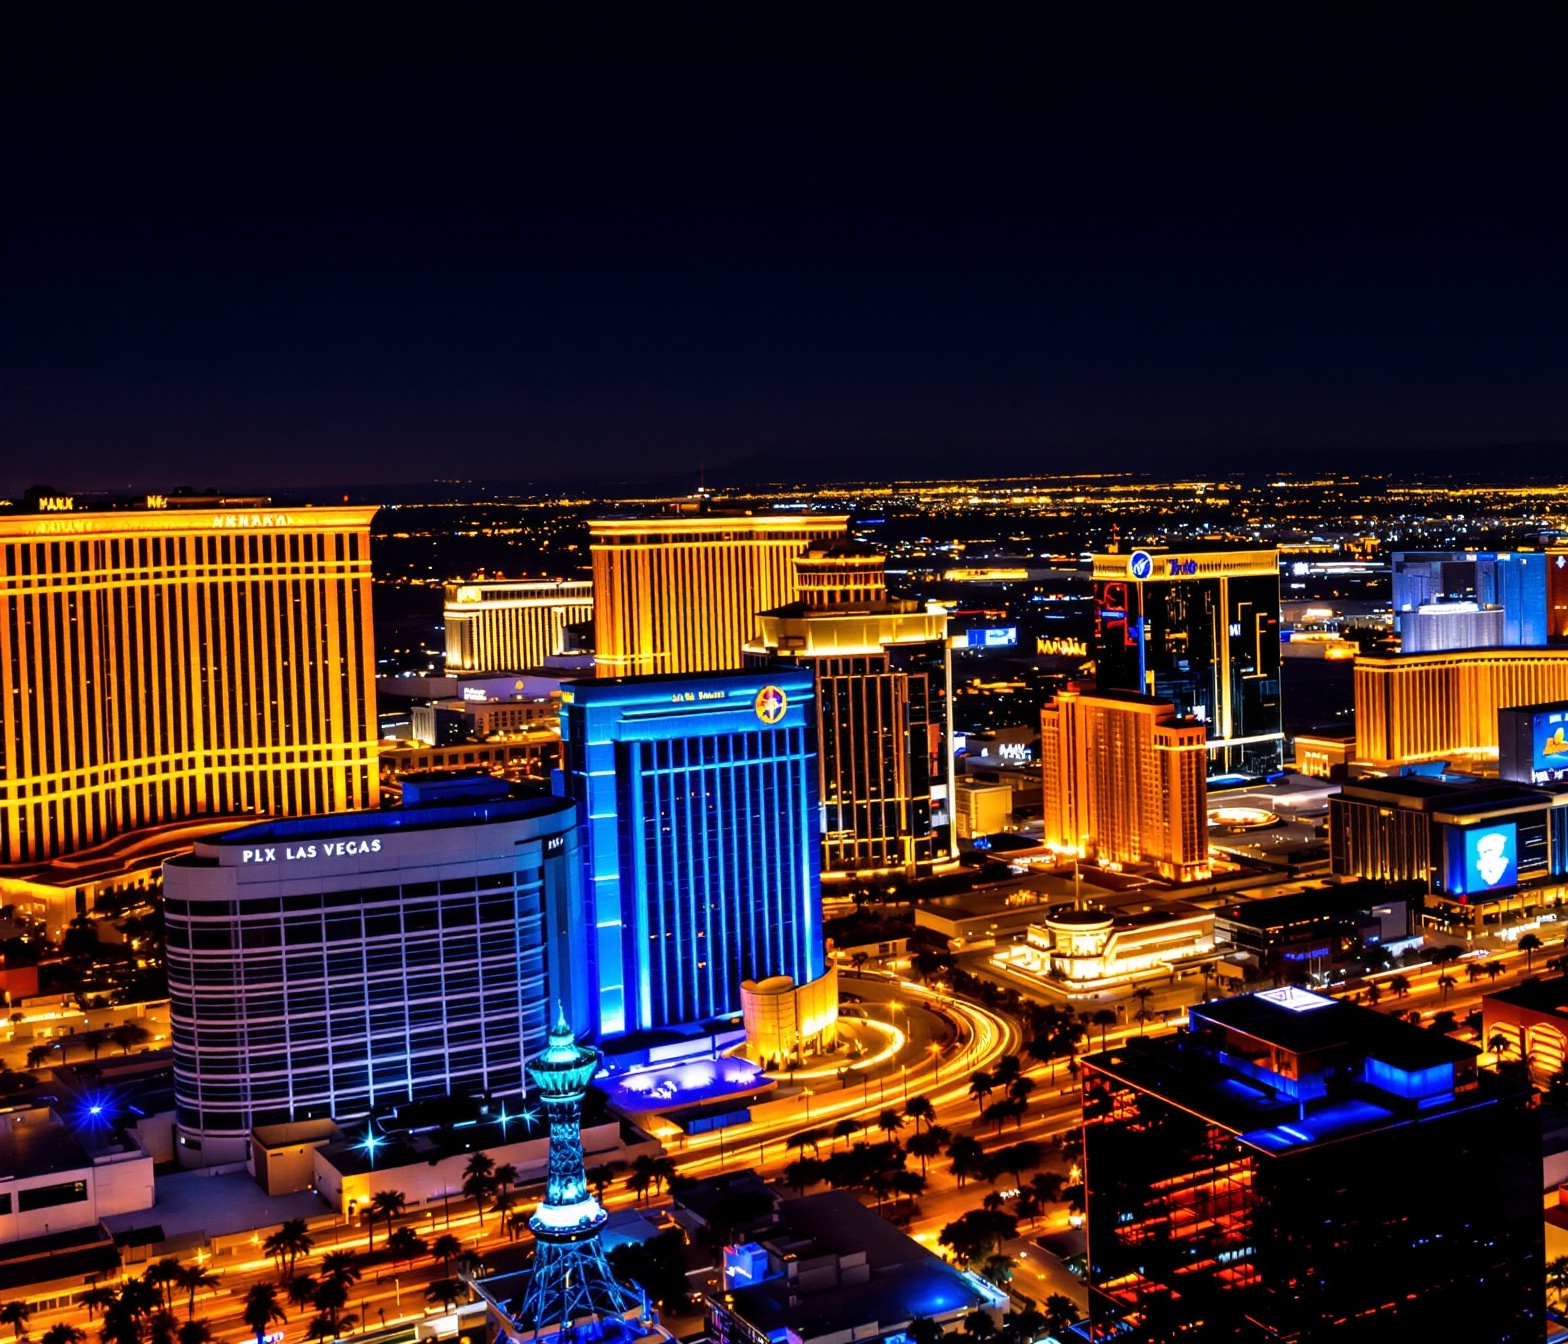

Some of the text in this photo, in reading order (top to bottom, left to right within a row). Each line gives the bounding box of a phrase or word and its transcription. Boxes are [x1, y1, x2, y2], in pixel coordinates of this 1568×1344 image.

[243, 839, 381, 862] PLX LAS VEGAS
